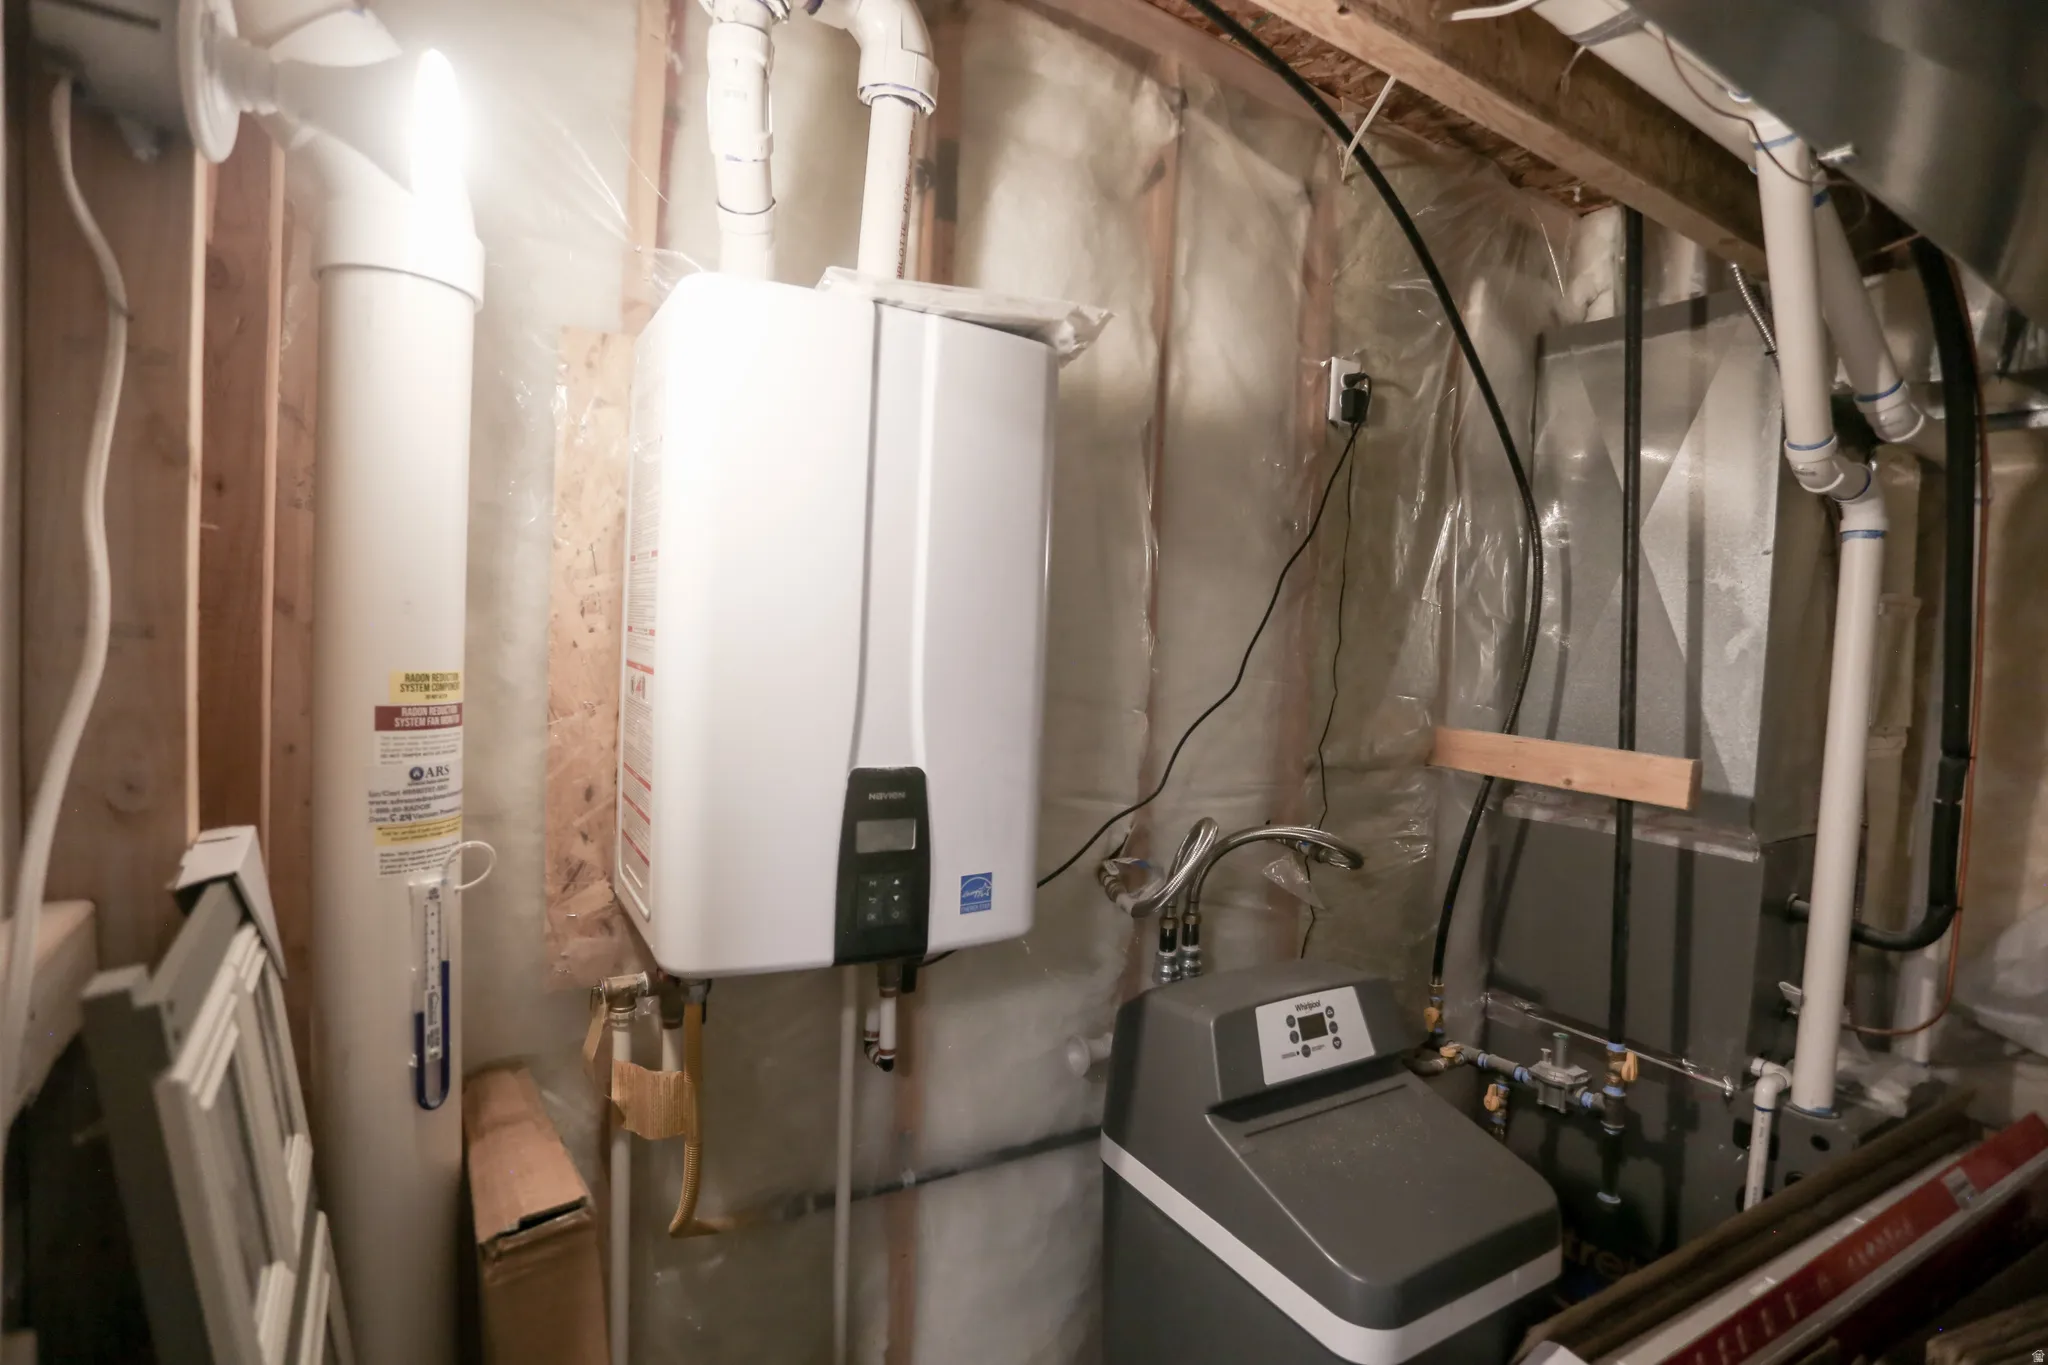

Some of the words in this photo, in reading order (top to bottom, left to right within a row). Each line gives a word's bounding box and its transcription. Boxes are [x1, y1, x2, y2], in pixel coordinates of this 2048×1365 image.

[404, 672, 430, 683] RADON
[400, 683, 430, 693] SYSTEM
[401, 706, 428, 718] RADON
[394, 717, 426, 728] SYSTEM
[426, 716, 440, 726] FAN
[425, 764, 450, 778] ARS
[1294, 1000, 1322, 1013] Whirlpool
